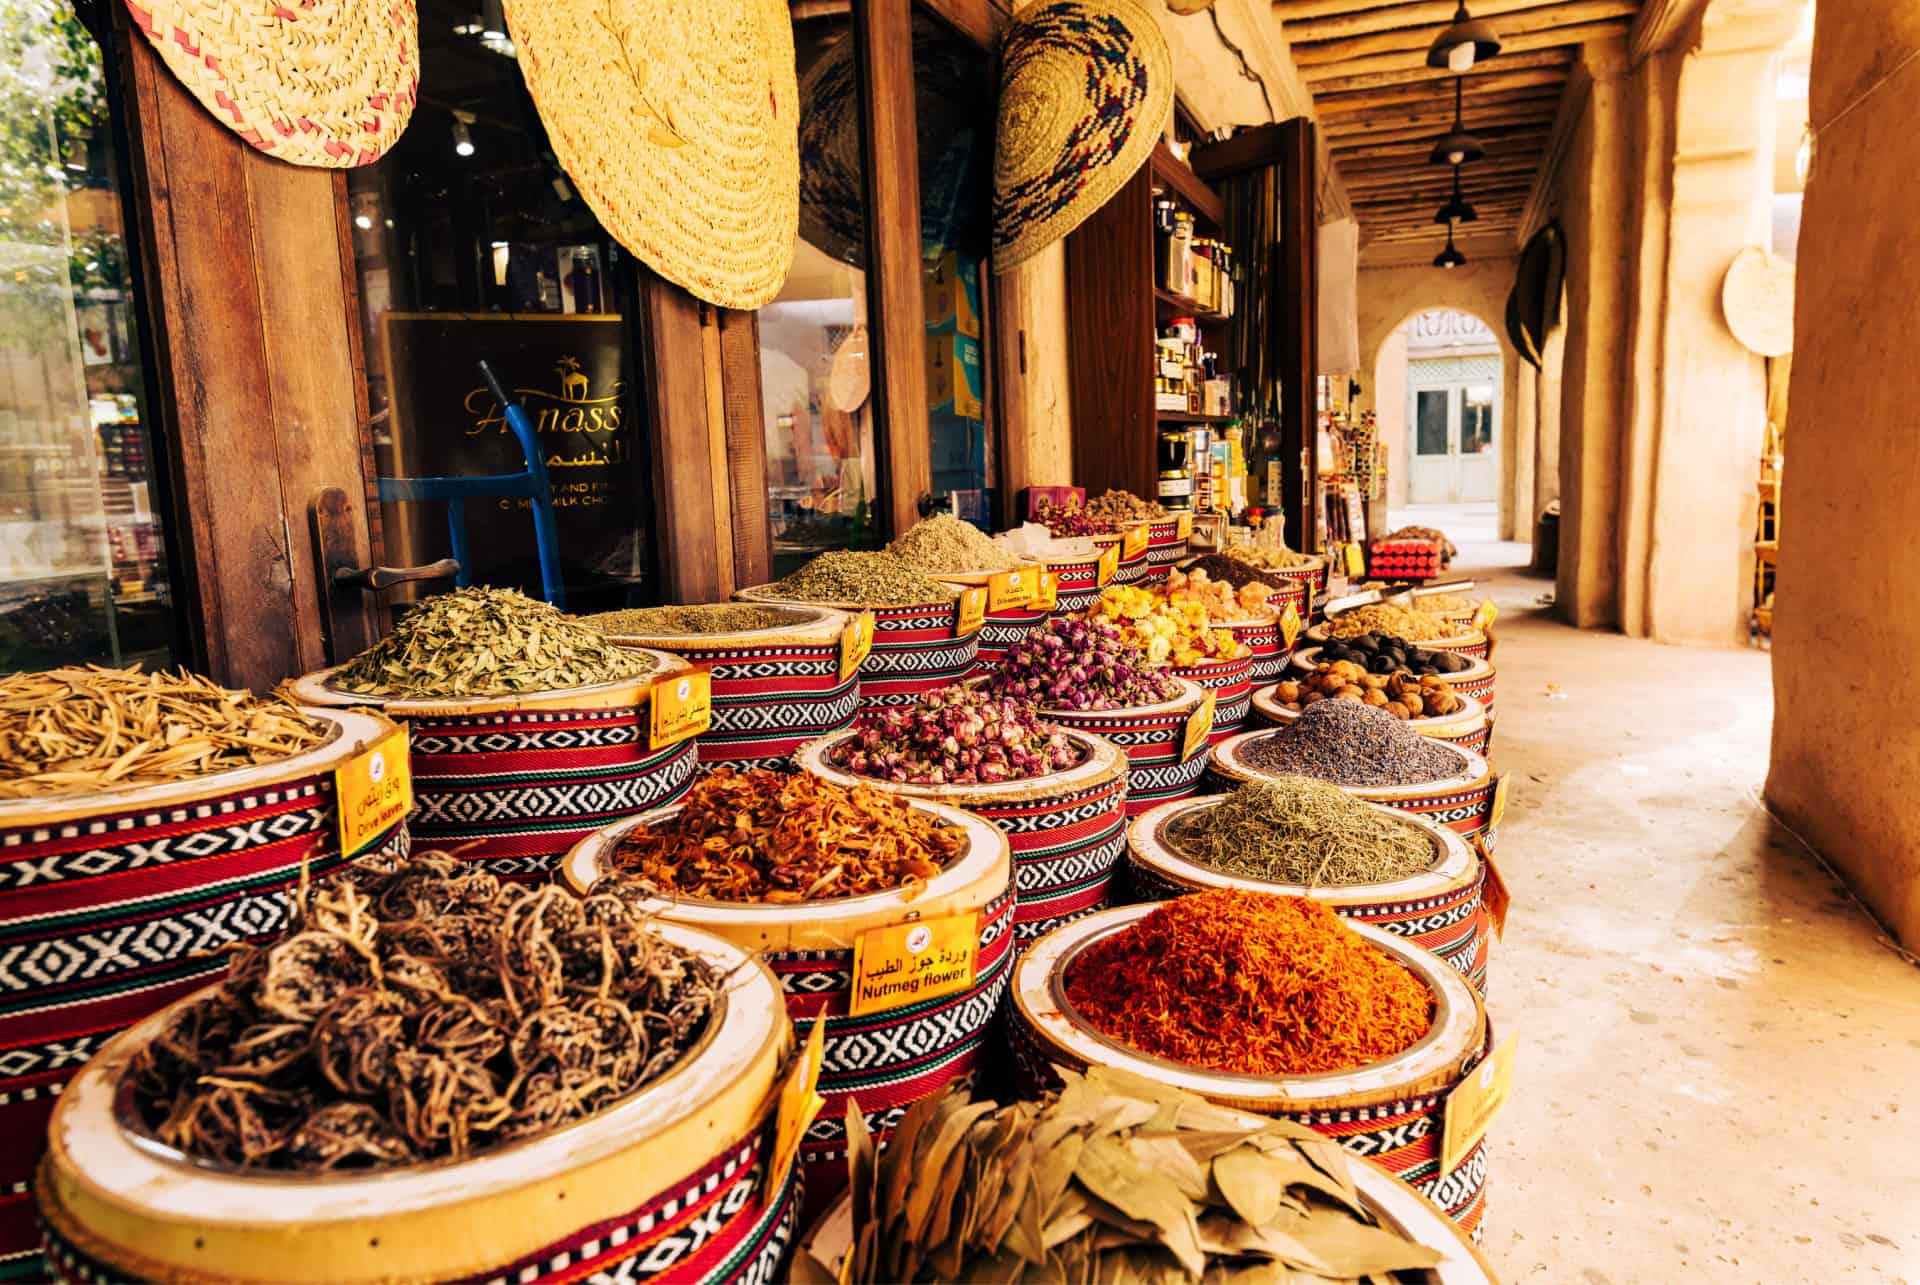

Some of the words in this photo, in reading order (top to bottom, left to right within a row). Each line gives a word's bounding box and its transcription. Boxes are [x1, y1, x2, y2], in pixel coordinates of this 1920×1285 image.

[908, 956, 934, 974] جوز
[939, 949, 967, 964] وردة
[866, 958, 902, 982] الطيب
[862, 979, 919, 1000] Nutmeg
[924, 967, 967, 987] flower
